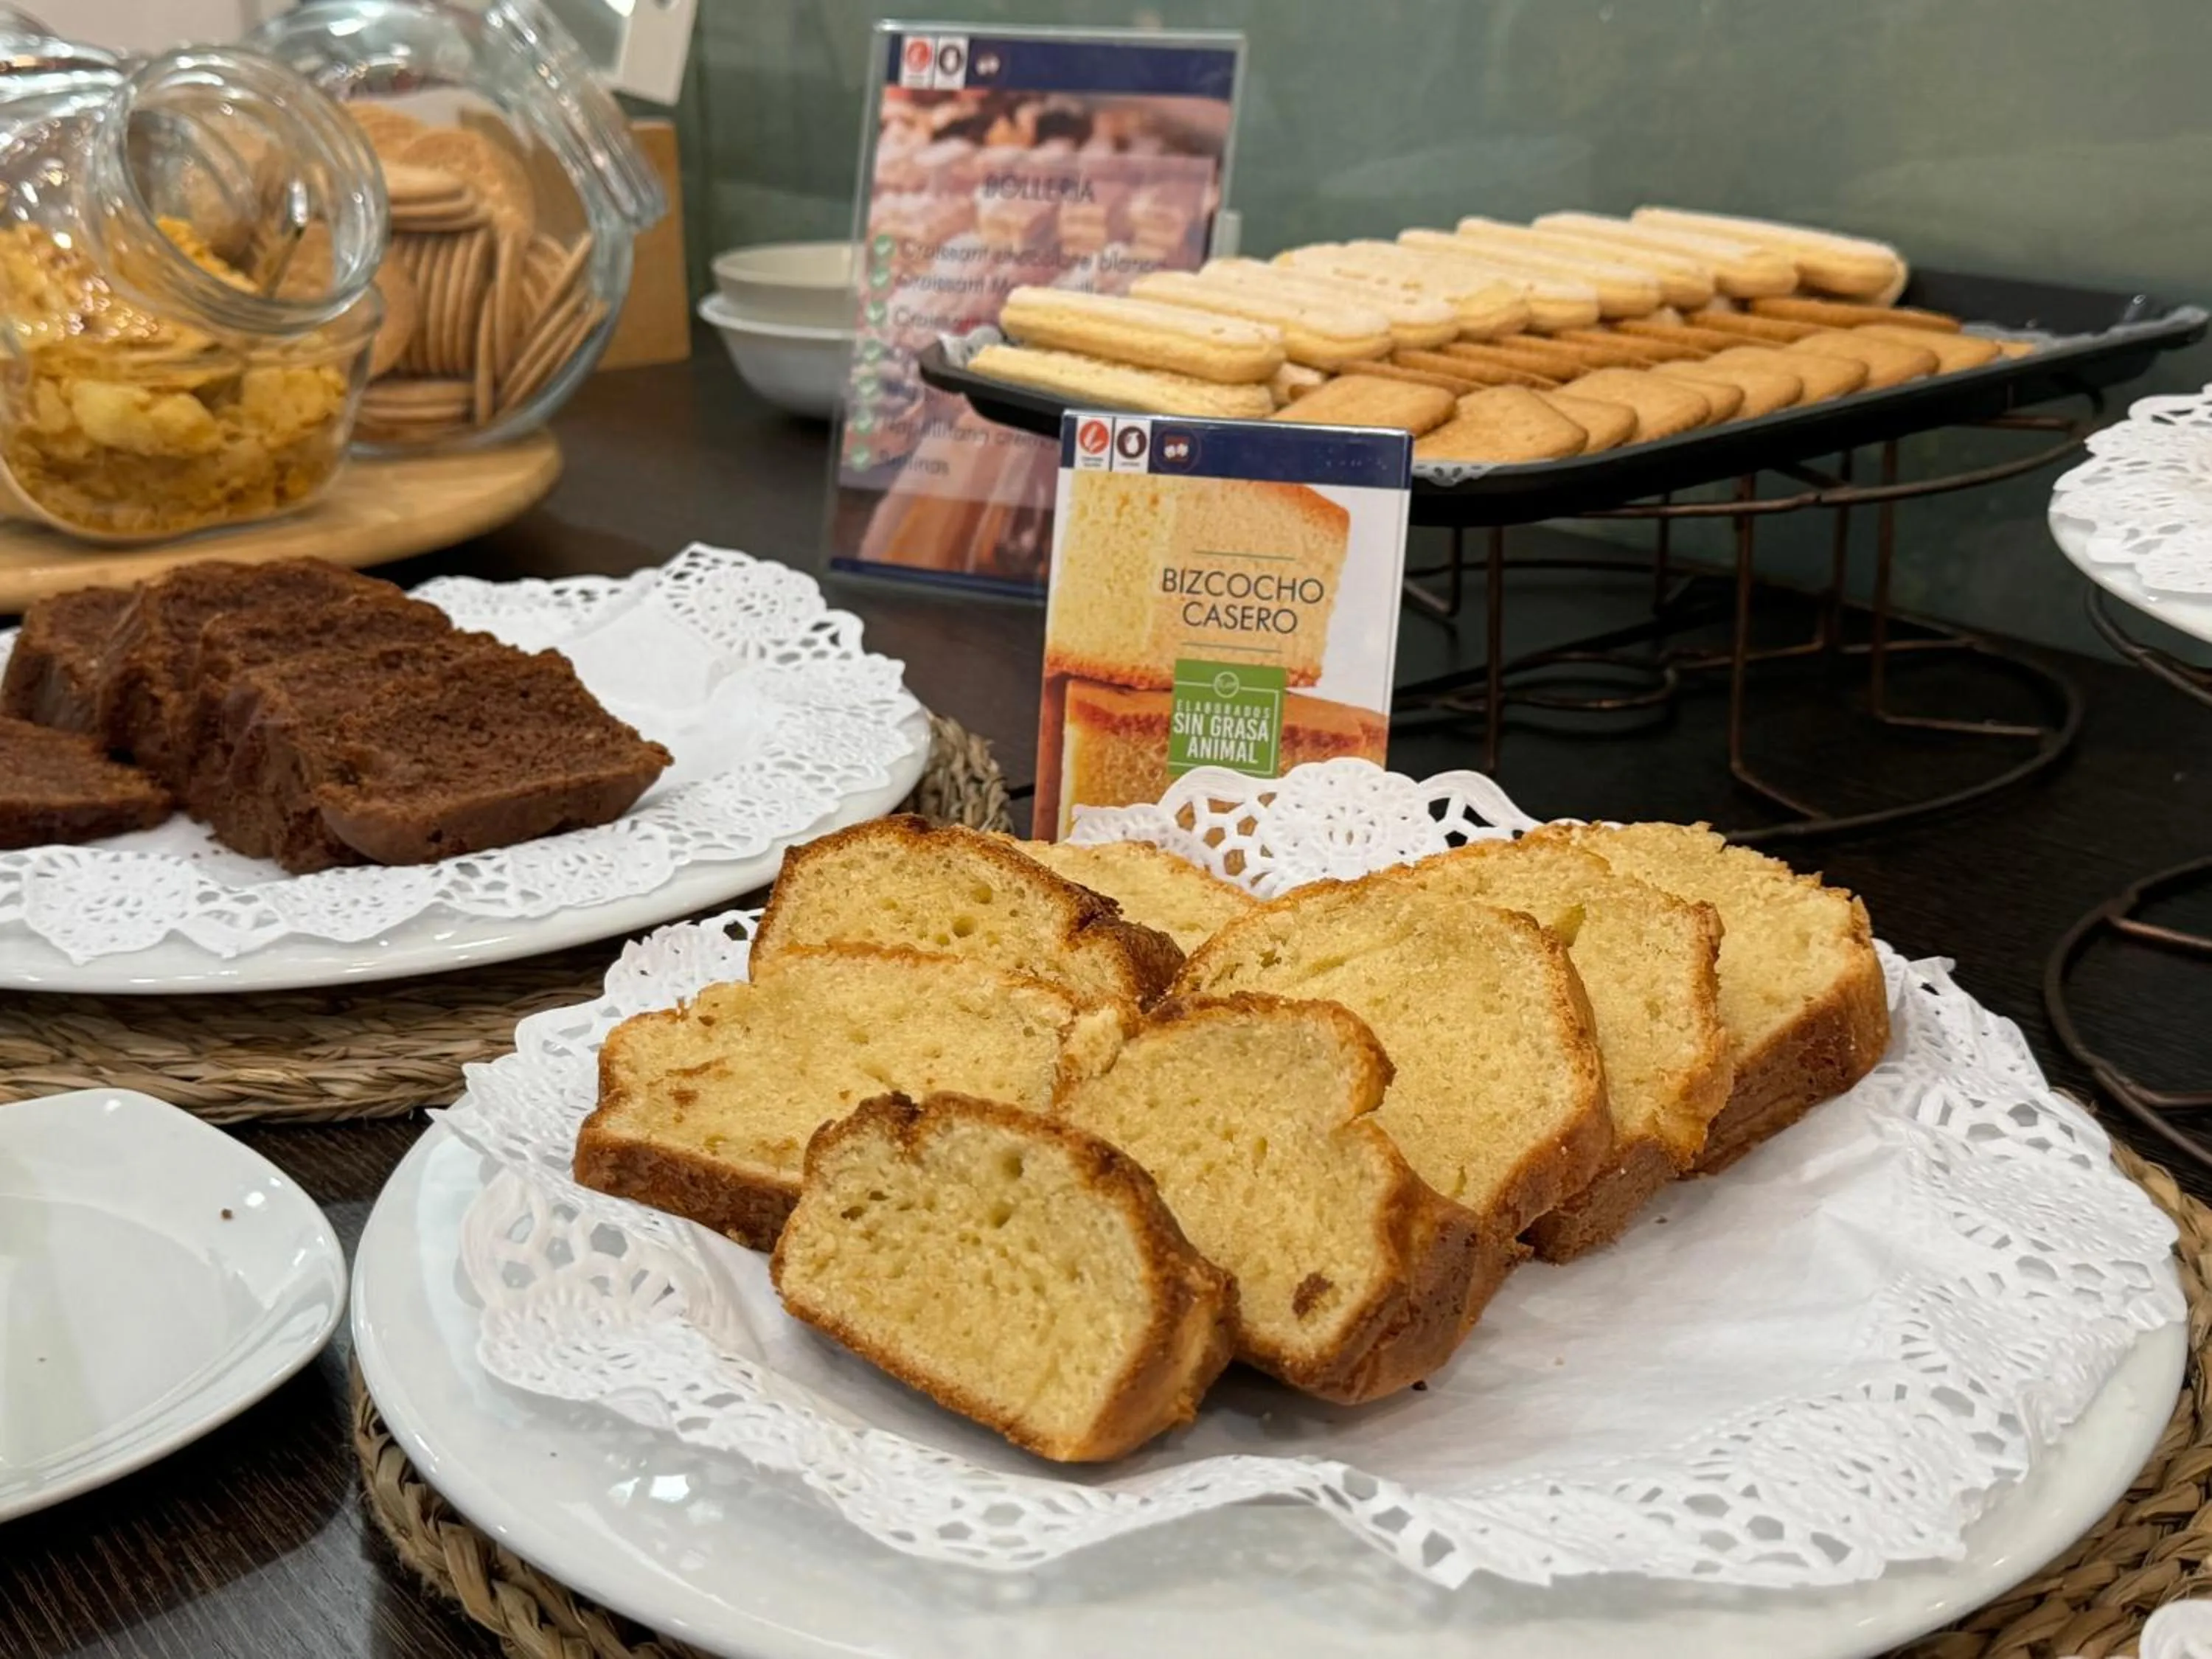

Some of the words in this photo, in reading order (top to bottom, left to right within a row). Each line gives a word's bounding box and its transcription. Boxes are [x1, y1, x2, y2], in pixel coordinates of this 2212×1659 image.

[1161, 567, 1324, 604] BIZCOCHO
[1182, 601, 1298, 634] CASERO
[1176, 698, 1271, 720] ELABORADOS
[1173, 712, 1205, 736] SIN
[1209, 715, 1270, 742] GRASA
[1186, 736, 1259, 765] ANIMAL
